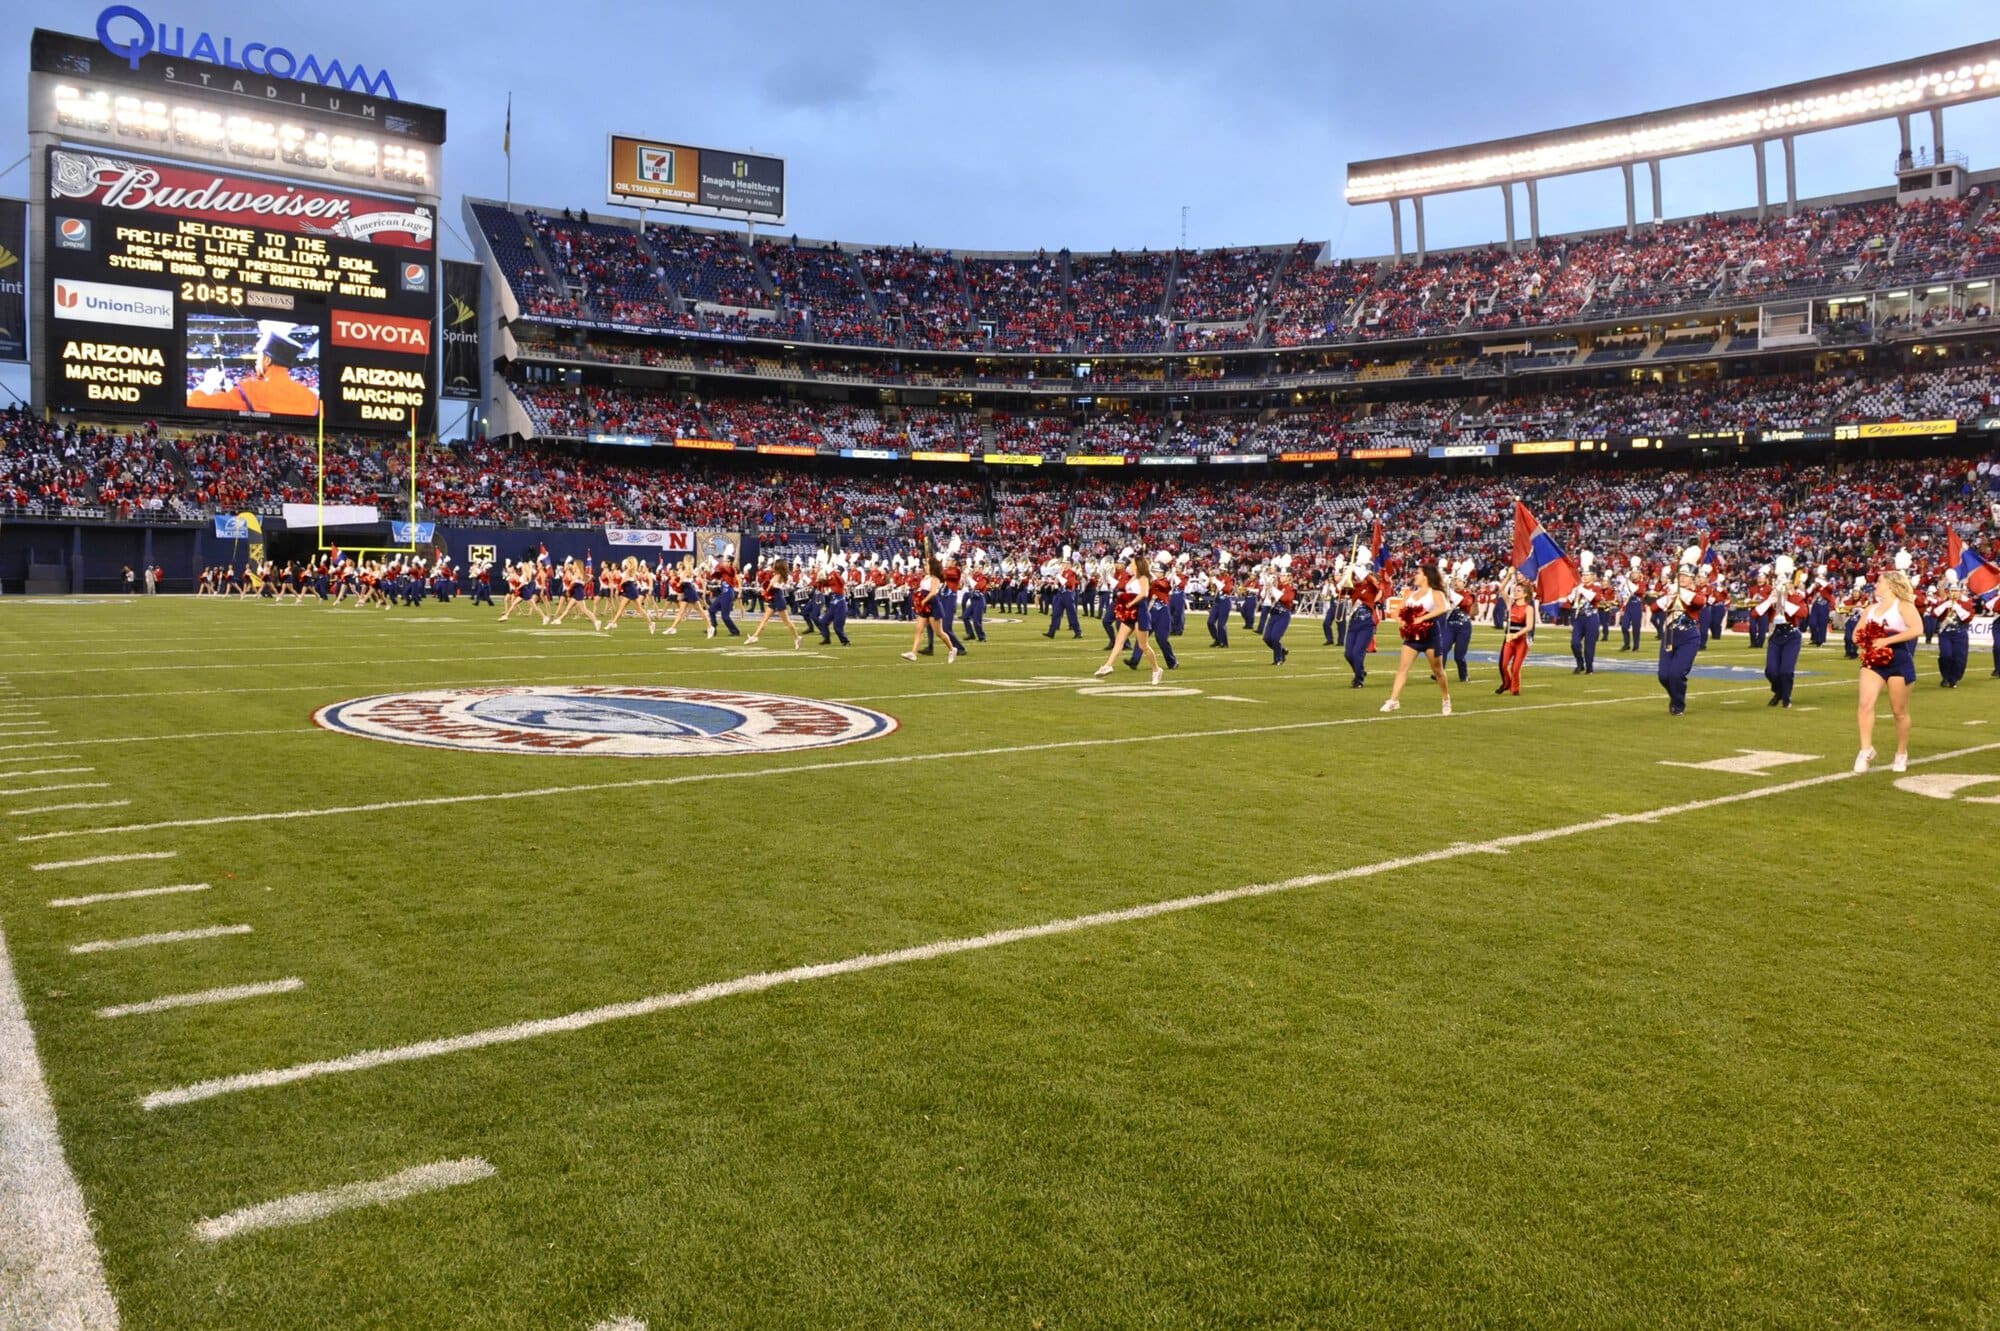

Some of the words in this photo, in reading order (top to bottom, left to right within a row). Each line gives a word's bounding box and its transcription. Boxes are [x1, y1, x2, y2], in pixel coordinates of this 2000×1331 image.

[96, 5, 399, 101] QUALCOMM
[165, 67, 376, 117] STADIUM
[631, 184, 661, 196] THANK
[702, 174, 736, 189] Imaging
[736, 180, 781, 193] Healthcare
[89, 168, 352, 220] Budweiser
[721, 194, 744, 203] Partner
[353, 218, 399, 234] American
[401, 218, 430, 232] Lager
[179, 221, 255, 243] WELCOME
[264, 232, 287, 248] TO
[295, 237, 326, 253] THE
[116, 227, 196, 249] PACIFIC
[205, 239, 249, 257] LIFE
[258, 246, 330, 266] HOLIDAY
[338, 256, 379, 273] BOWL
[126, 244, 197, 263] PRE-GAME
[204, 254, 239, 269] SHOW
[246, 259, 318, 278] PRESENTED
[324, 270, 341, 281] BY
[348, 272, 371, 284] THE
[109, 254, 164, 272] SYCUAN
[170, 262, 205, 277] BAND
[213, 268, 230, 280] OF
[238, 270, 263, 284] THE
[339, 284, 386, 299] NATION
[0, 279, 24, 295] int
[181, 282, 244, 306] 20:55
[86, 296, 171, 317] UnionBank
[336, 320, 426, 346] TOYOTA
[442, 328, 479, 344] Sprint
[62, 340, 165, 367] ARIZONA
[65, 364, 163, 386] MARCHING
[341, 366, 426, 389] ARIZONA
[88, 384, 140, 402] BAND
[342, 387, 424, 406] MARCHING
[361, 405, 405, 421] BAND
[675, 439, 705, 448] WELLS
[705, 441, 734, 450] FARGO
[1445, 445, 1486, 456] GEICO
[1282, 453, 1309, 461] WELLS
[1310, 452, 1337, 460] FARGO
[669, 532, 687, 549] N
[472, 545, 493, 562] 25
